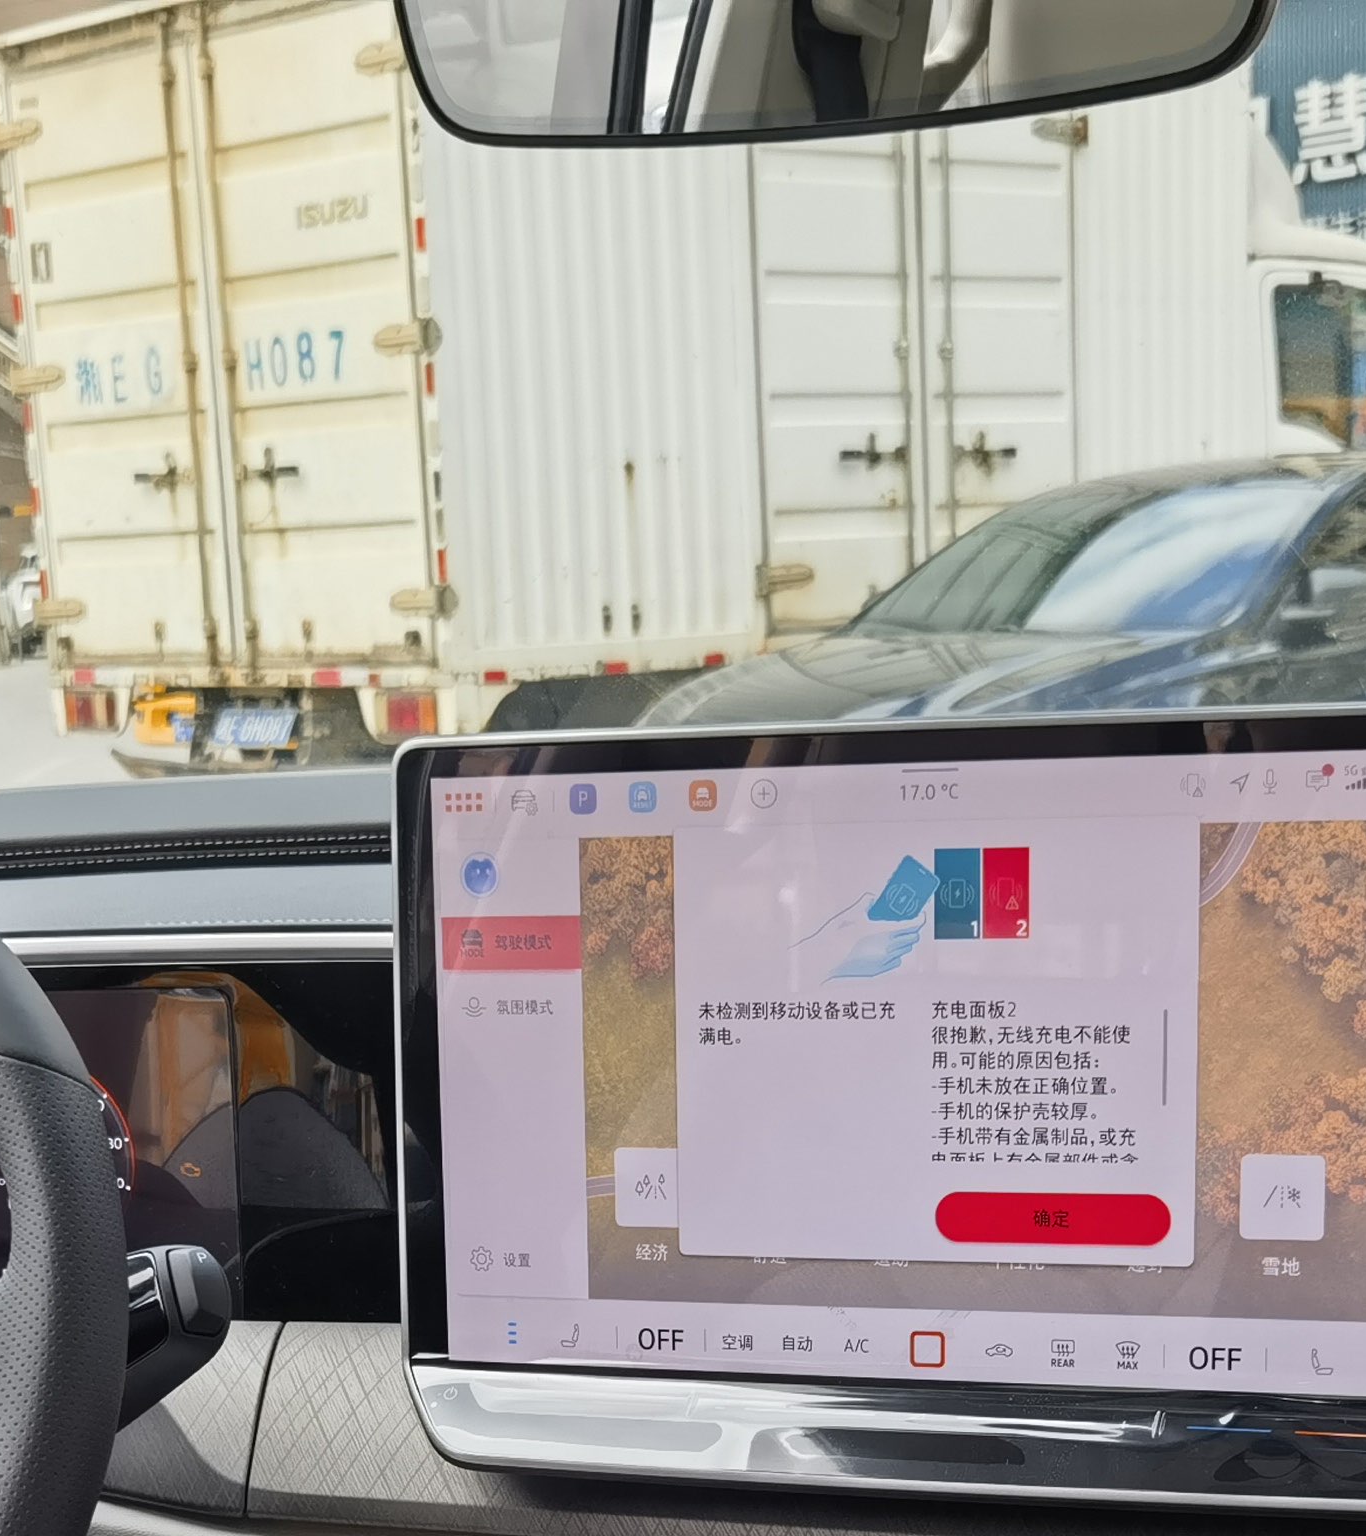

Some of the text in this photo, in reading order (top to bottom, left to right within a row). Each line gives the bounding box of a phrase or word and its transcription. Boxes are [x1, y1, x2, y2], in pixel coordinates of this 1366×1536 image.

[296, 195, 368, 229] ISUZU
[900, 785, 936, 801] 17.0
[970, 920, 978, 937] 1
[1016, 919, 1028, 937] 2
[495, 935, 552, 951] 驾驶模式
[496, 1000, 553, 1016] 氛围模式
[698, 1001, 896, 1021] 未检测到移动设备或已充
[931, 1000, 1017, 1020] 充电面板2
[698, 1027, 743, 1046] 满电。
[931, 1076, 1118, 1096] -手机未放在正确位置。
[931, 1102, 1098, 1121] -手机的保护壳较厚。
[1033, 1210, 1070, 1229] 确定
[196, 1252, 208, 1264] P
[503, 1253, 532, 1268] 设置
[635, 1243, 669, 1262] 经济
[1261, 1257, 1301, 1276] 雪地
[638, 1328, 684, 1351] OFF
[721, 1334, 754, 1352] 空调
[782, 1335, 814, 1352] 自动
[844, 1339, 870, 1354] A/C
[1051, 1358, 1075, 1368] REAR
[1116, 1360, 1139, 1370] MAX
[1189, 1347, 1242, 1371] OFF
